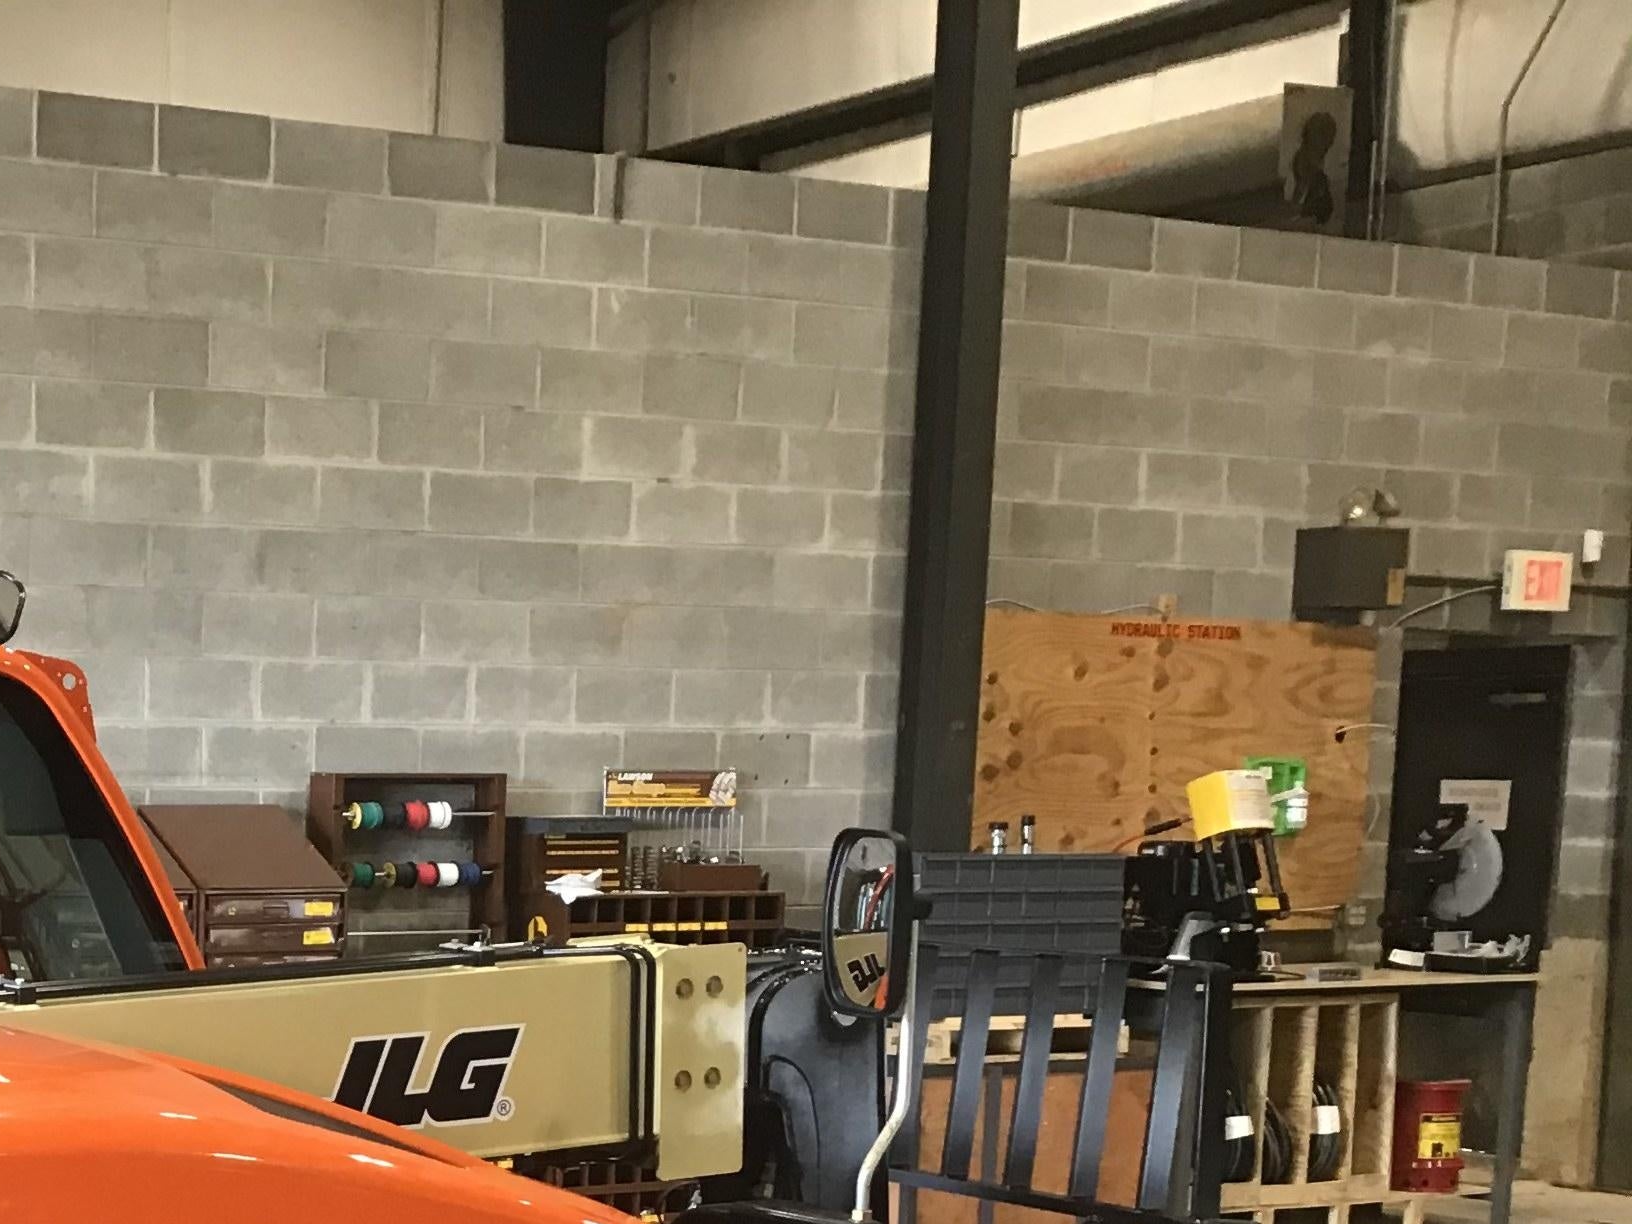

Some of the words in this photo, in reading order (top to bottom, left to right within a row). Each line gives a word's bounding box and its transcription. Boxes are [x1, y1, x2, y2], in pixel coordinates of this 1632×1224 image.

[1110, 622, 1180, 638] HYDRAULIC
[1187, 624, 1241, 640] STATION
[333, 1023, 525, 1127] JLG
